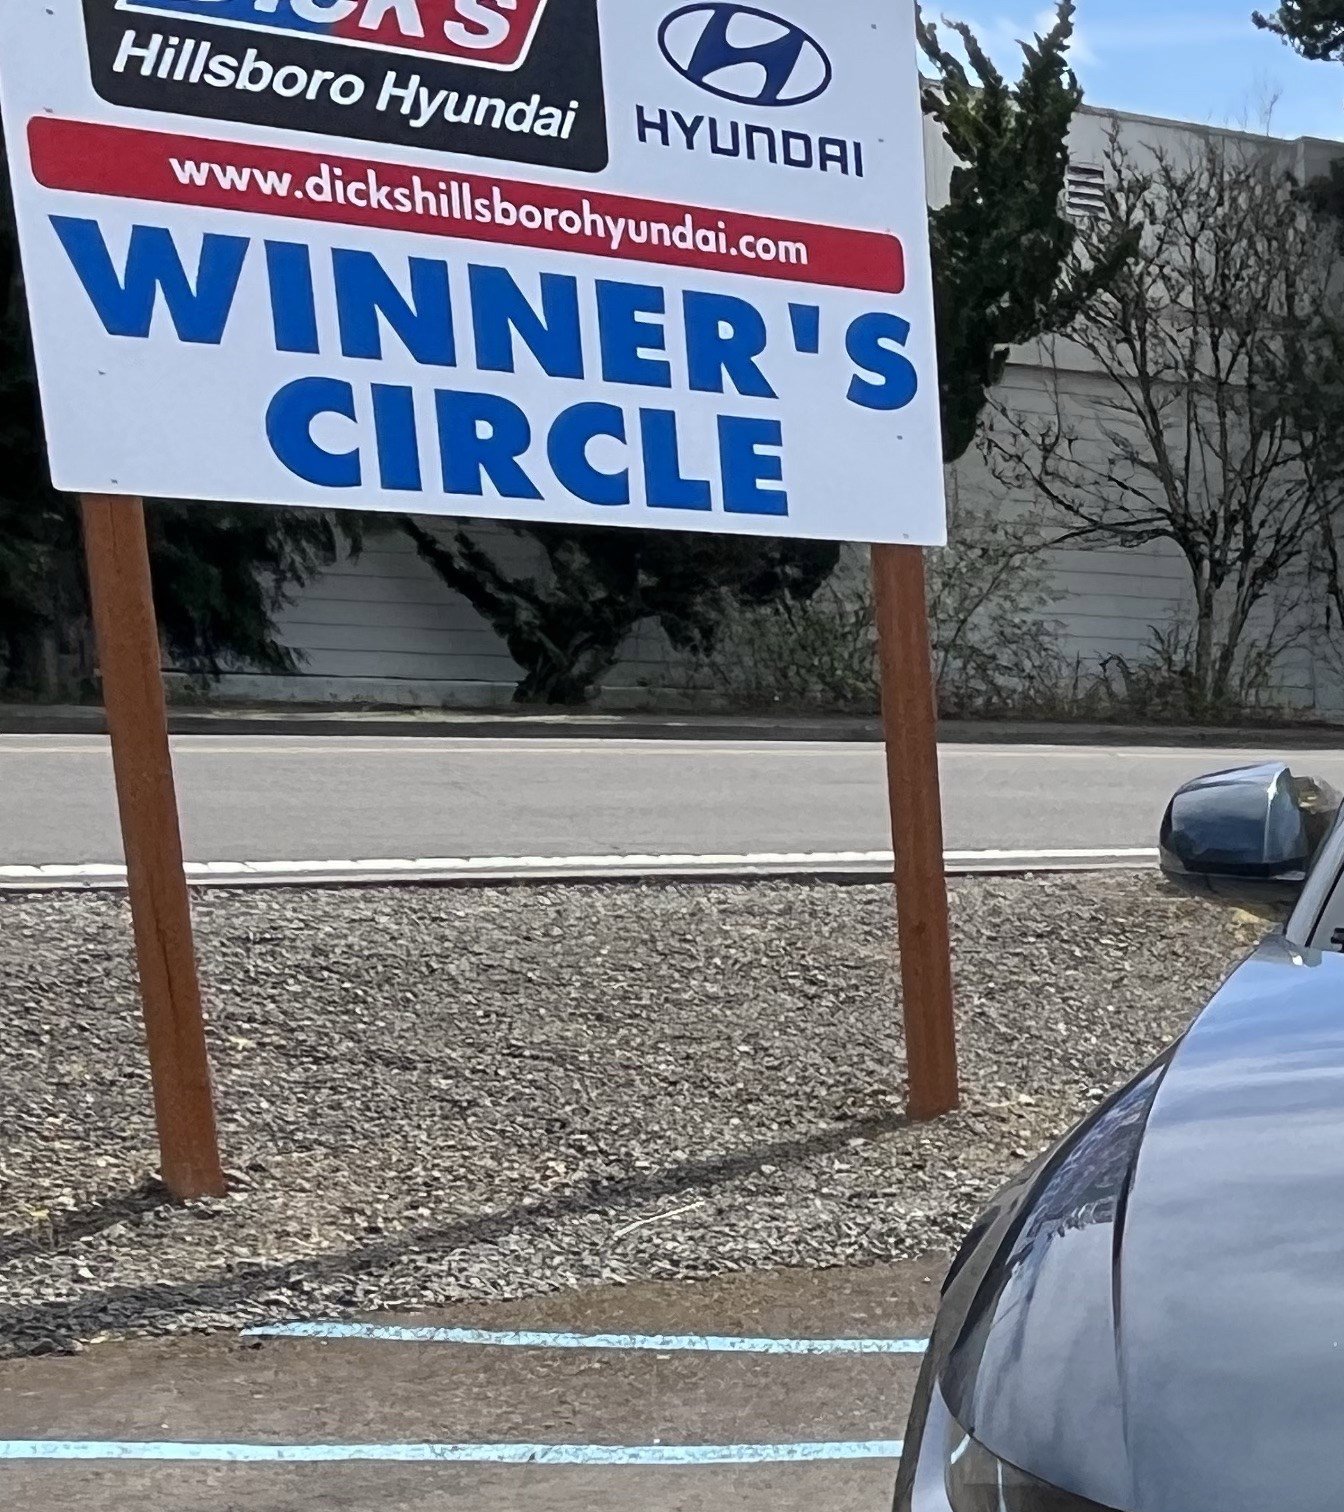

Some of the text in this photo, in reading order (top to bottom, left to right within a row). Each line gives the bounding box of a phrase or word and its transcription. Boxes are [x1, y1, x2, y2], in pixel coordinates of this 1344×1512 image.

[112, 29, 580, 139] Hillsboro Hyundai
[635, 104, 864, 178] HYUNDAI
[170, 152, 809, 266] www.dickshillsborohyundai.com
[48, 215, 918, 411] WINNER'S
[266, 376, 788, 517] CIRCLE
